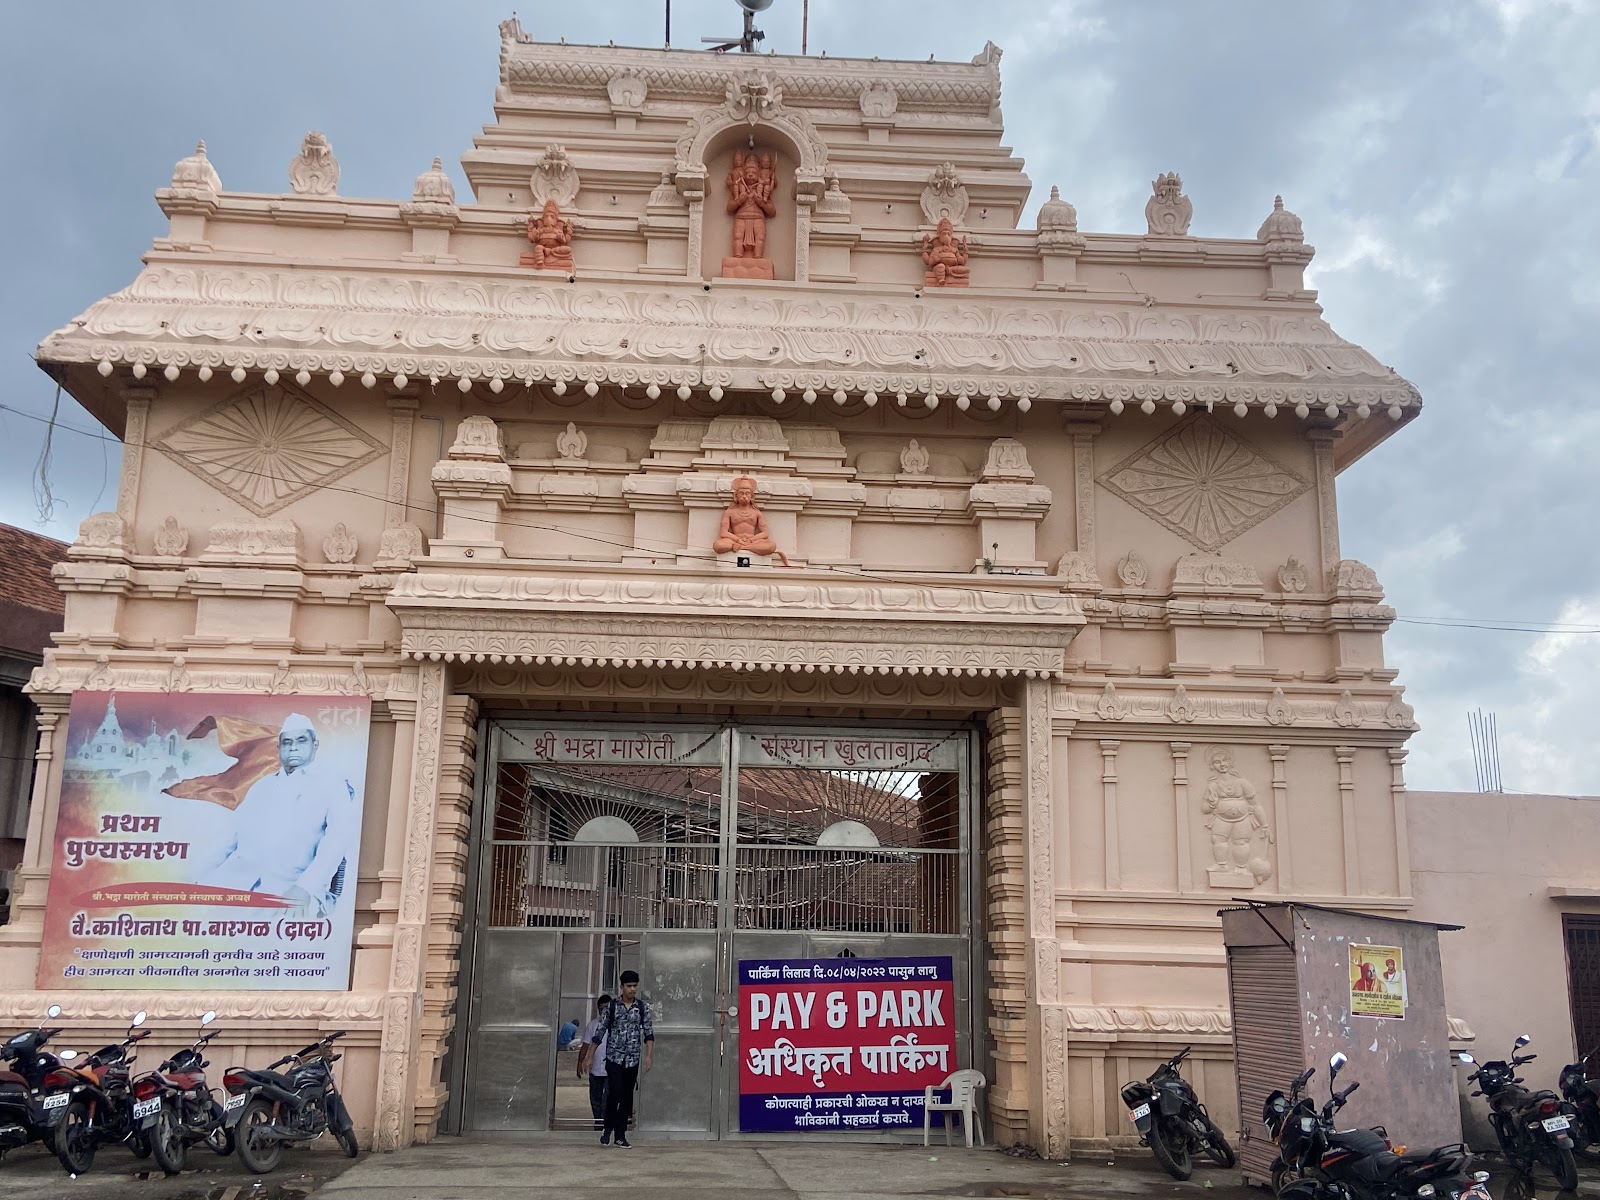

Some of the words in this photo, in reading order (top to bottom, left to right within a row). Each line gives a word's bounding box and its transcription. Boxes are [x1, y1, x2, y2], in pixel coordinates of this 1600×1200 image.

[317, 704, 364, 729] दादा
[533, 731, 557, 759] श्री
[564, 738, 605, 760] भद्रा
[610, 732, 675, 760] मारोती
[761, 734, 829, 759] संस्थान
[833, 739, 932, 766] खुलताबाद
[100, 814, 162, 834] प्रथम
[66, 840, 191, 867] पुण्यस्मरण
[123, 891, 150, 902] मारोती
[151, 891, 187, 902] संस्थानचे
[189, 892, 224, 902] संस्थापक
[182, 916, 272, 939] पा.बारगळ
[275, 917, 333, 942] (दादा)
[138, 948, 209, 960] आमच्यामनी
[212, 948, 253, 963] तुमचीच
[257, 948, 280, 960] आहे
[283, 951, 325, 961] आठवण
[63, 965, 85, 978] हीच
[88, 967, 135, 977] आमच्या
[139, 965, 200, 977] जीवनातील
[202, 965, 249, 977] अनमोल
[253, 965, 281, 977] अशी
[748, 965, 780, 980] पार्किंग
[782, 964, 811, 980] लिलाव
[888, 966, 915, 981] पासुन
[917, 965, 938, 981] लागु
[750, 991, 816, 1030] PAY
[826, 991, 848, 1029] &
[857, 989, 946, 1028] PARK
[746, 1037, 854, 1088] अधिकृत
[859, 1033, 950, 1075] पार्किंग
[134, 1103, 161, 1118] 6944
[765, 1095, 812, 1111] कोणत्याही
[815, 1094, 854, 1109] प्रकारची
[856, 1093, 888, 1108] ओळख
[891, 1096, 900, 1107] न
[902, 1095, 942, 1107] दाखता
[794, 1111, 840, 1127] भाविकांनी
[842, 1110, 880, 1126] सहकार्य
[882, 1111, 913, 1125] करावे.
